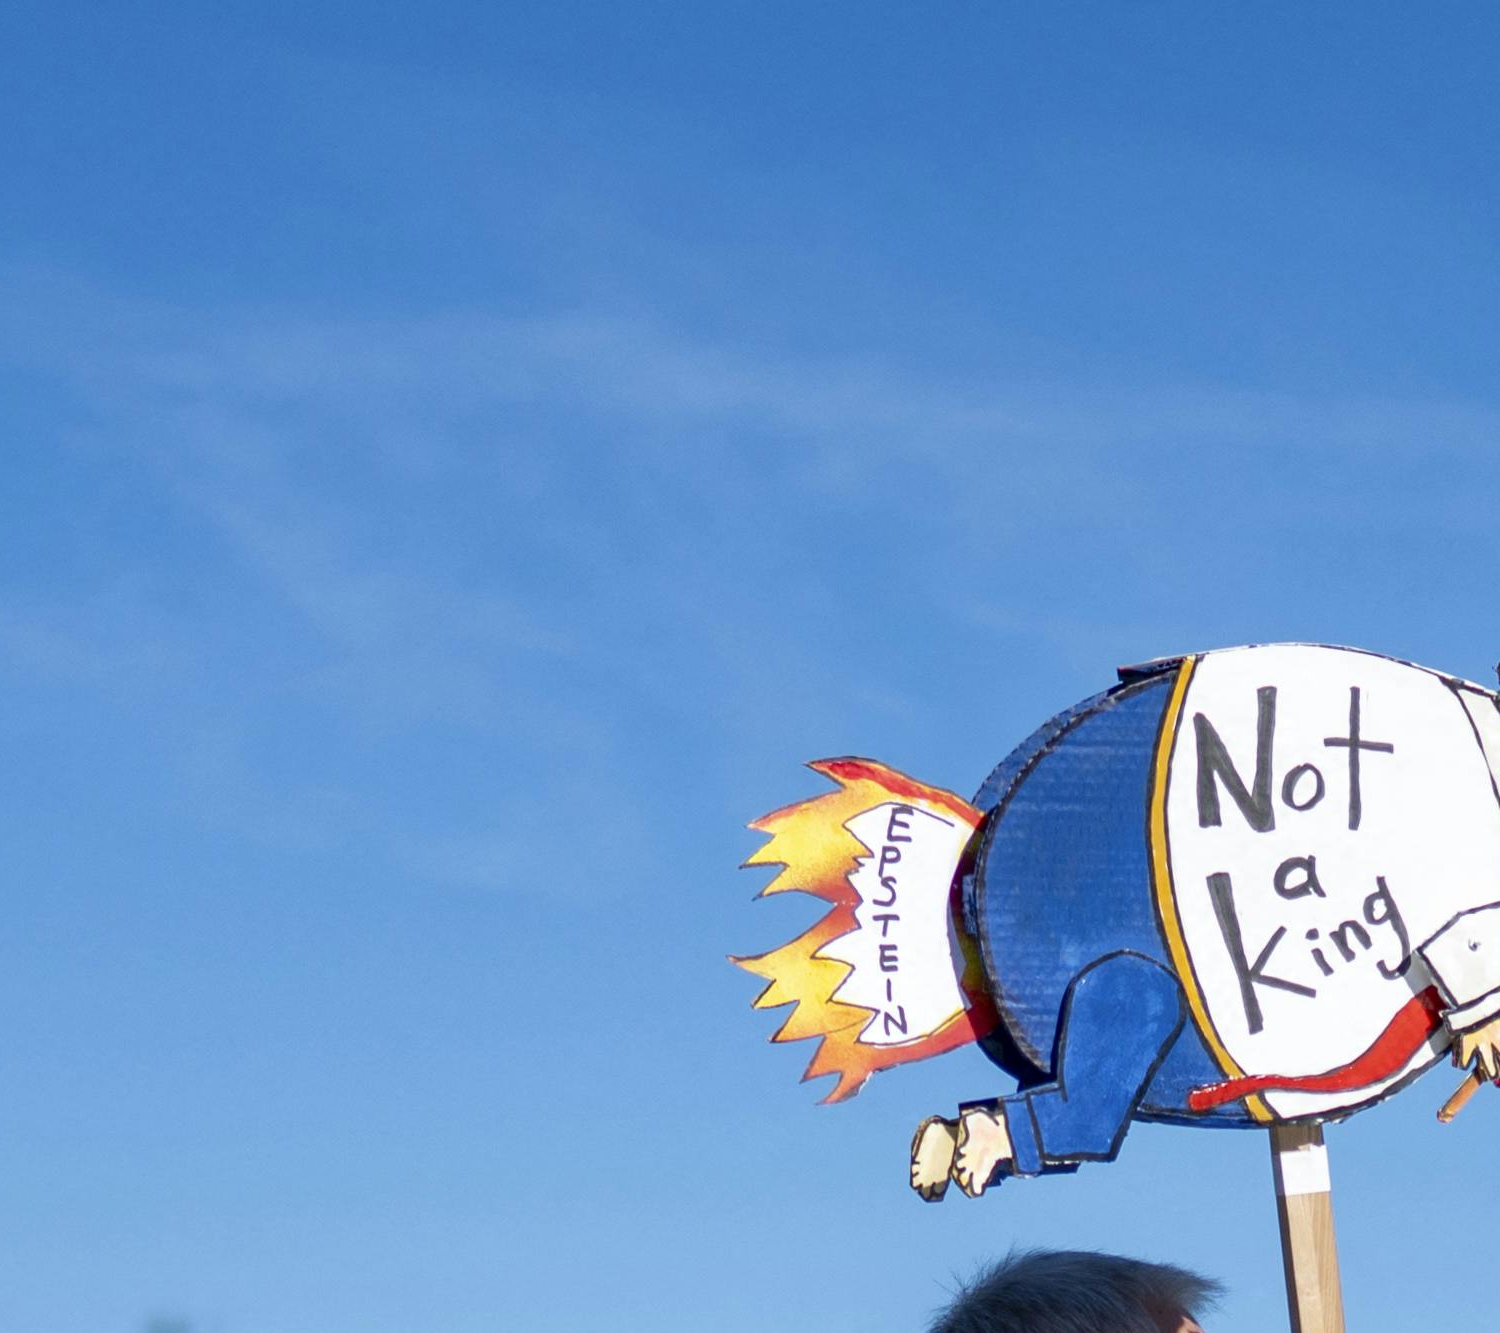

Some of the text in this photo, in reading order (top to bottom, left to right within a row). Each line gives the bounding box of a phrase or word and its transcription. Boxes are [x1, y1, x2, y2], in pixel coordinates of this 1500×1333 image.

[1193, 686, 1394, 832] Not
[872, 806, 914, 1036] EPSTEIN
[1206, 872, 1411, 1034] King
[1273, 855, 1326, 900] a
